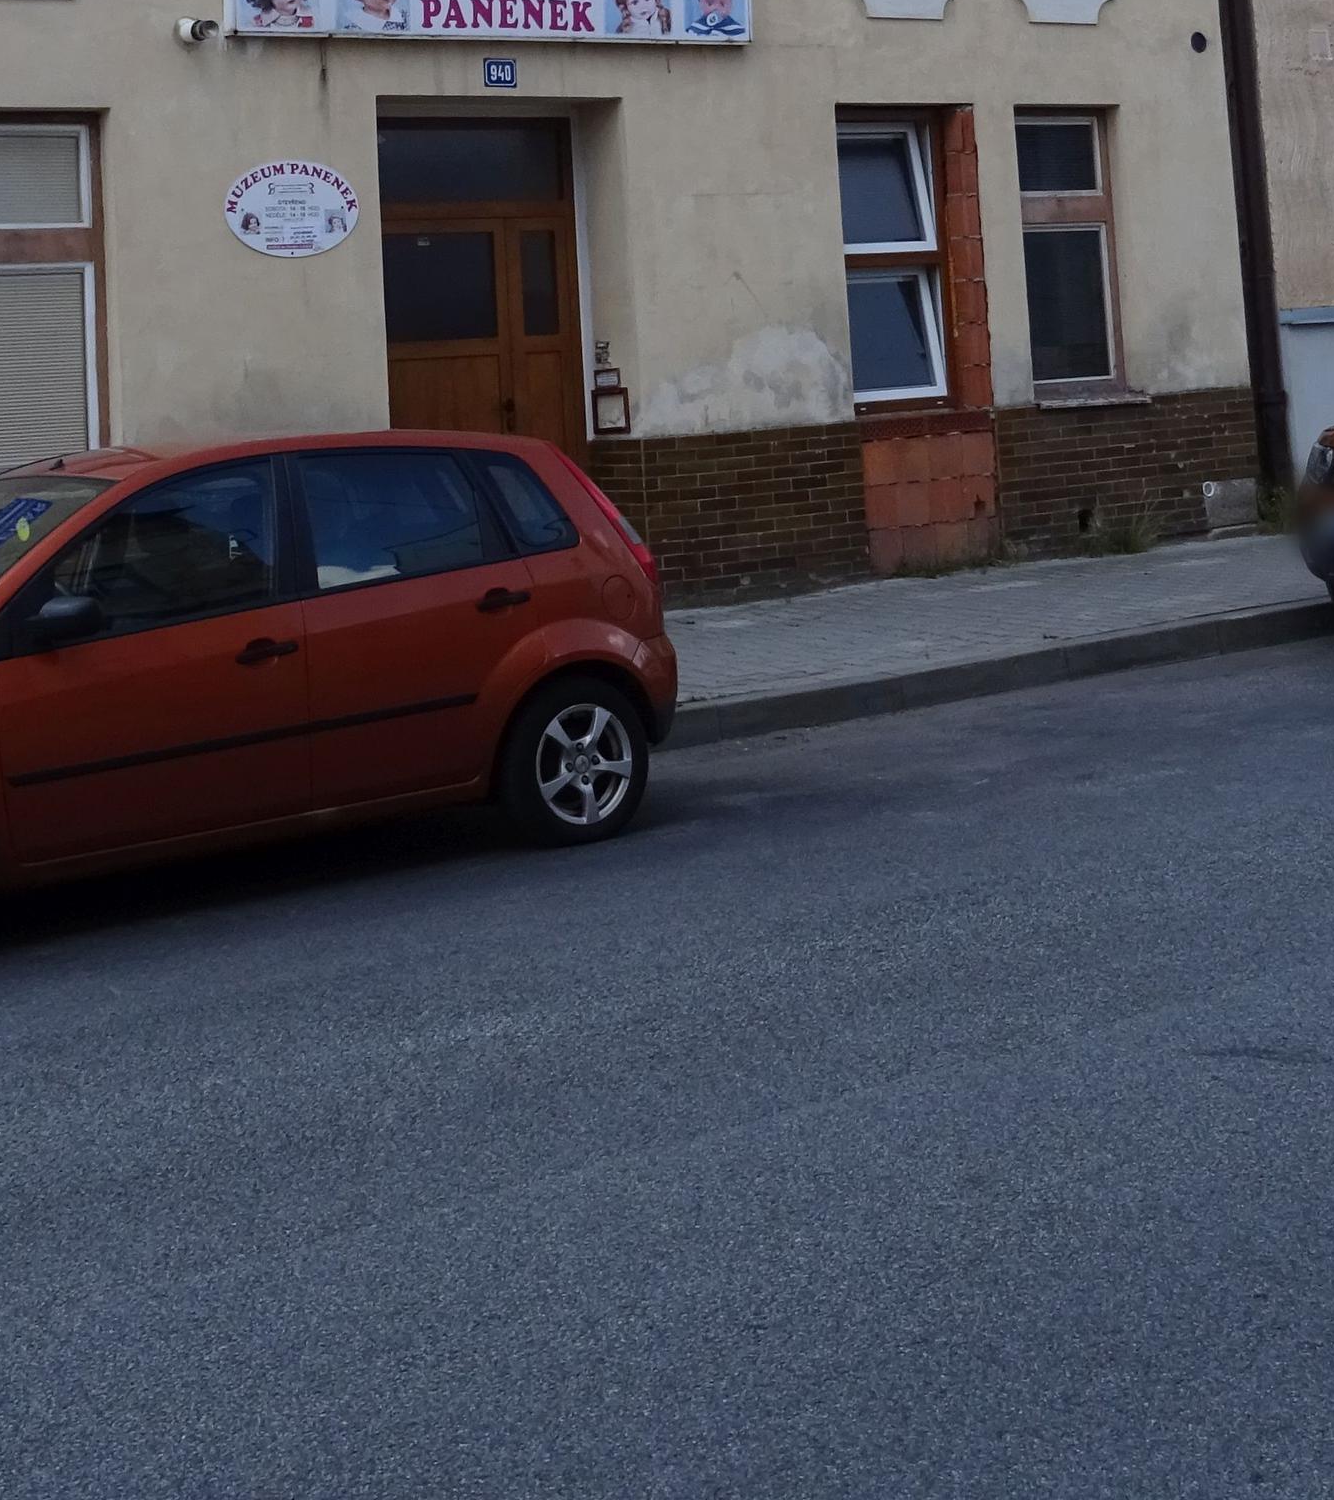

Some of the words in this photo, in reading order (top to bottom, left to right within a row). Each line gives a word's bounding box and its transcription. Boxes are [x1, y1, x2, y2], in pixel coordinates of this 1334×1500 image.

[490, 64, 512, 81] 940
[226, 163, 286, 214] MUZEUM
[290, 163, 358, 212] PANENEK
